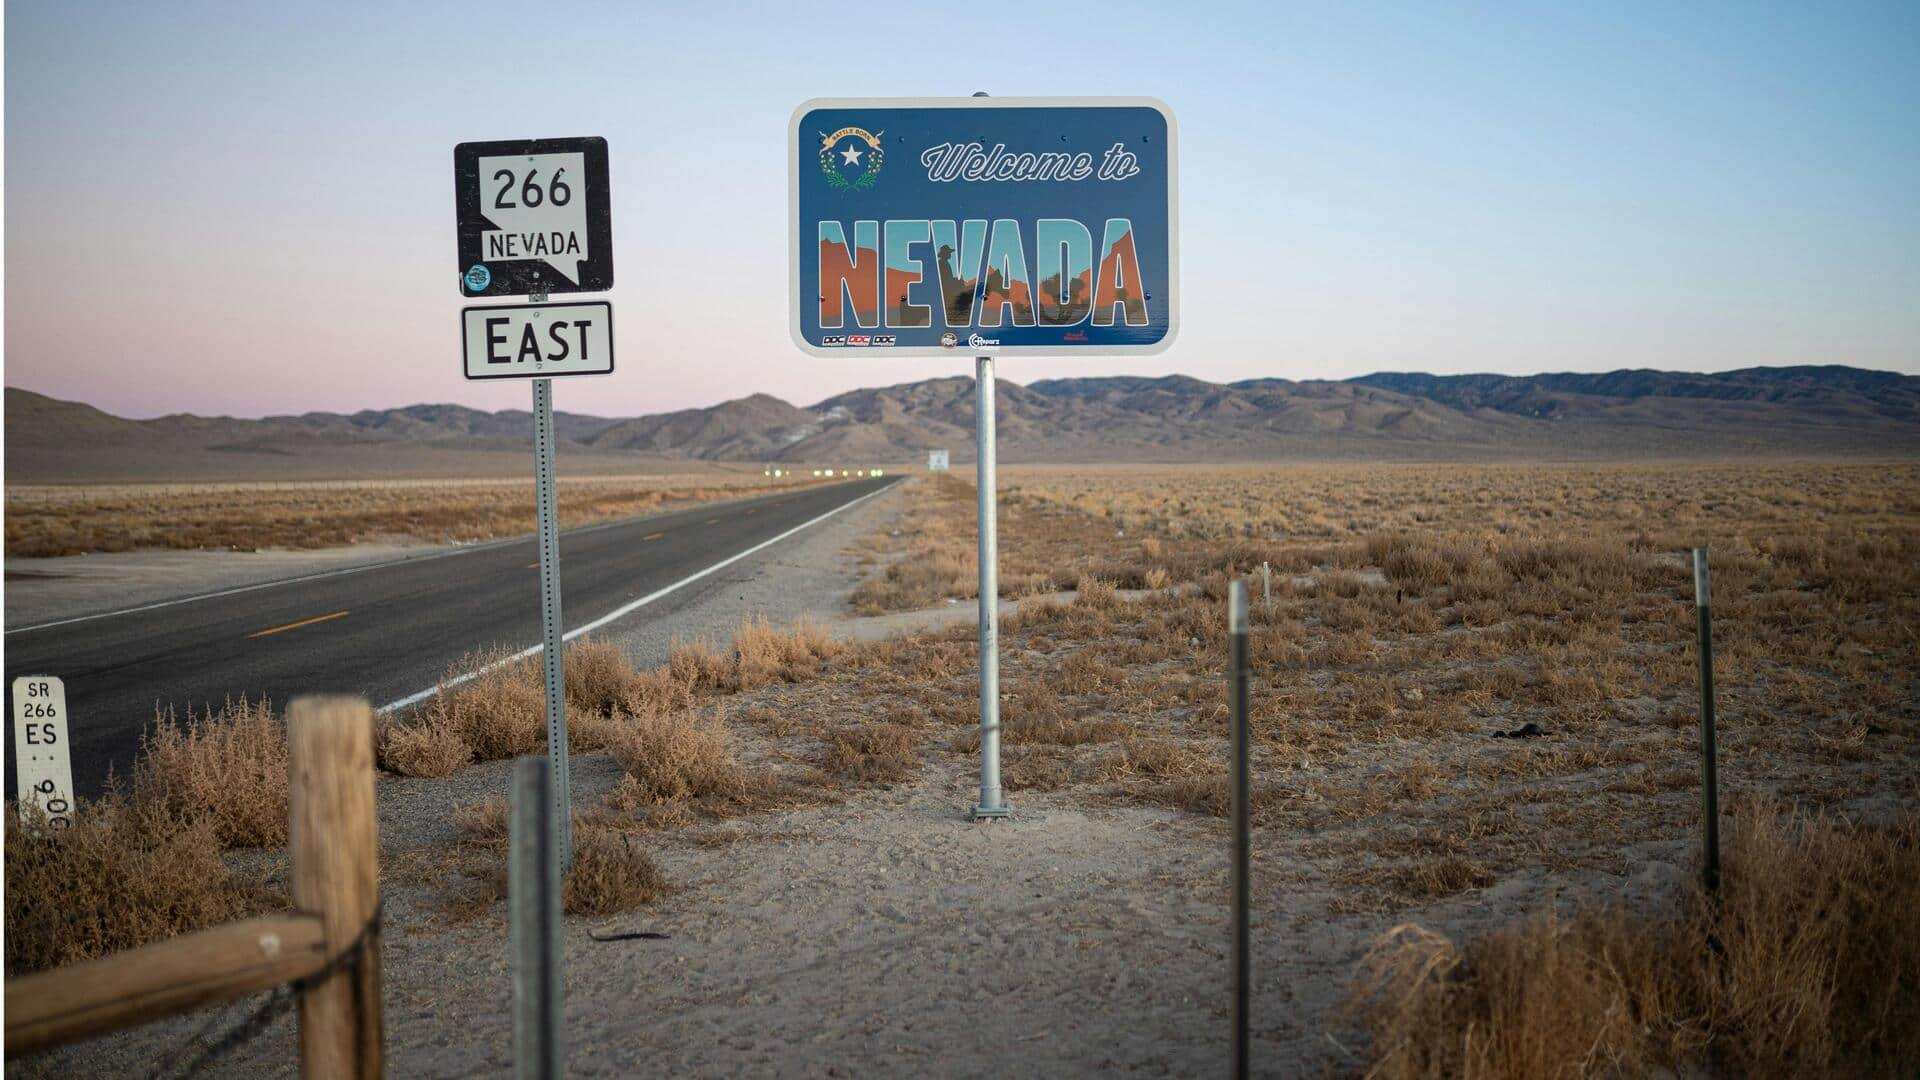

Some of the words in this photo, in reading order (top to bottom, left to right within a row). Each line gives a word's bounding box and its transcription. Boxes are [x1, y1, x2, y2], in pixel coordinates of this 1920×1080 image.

[920, 142, 1093, 182] Welcome
[1097, 143, 1140, 181] to
[493, 167, 571, 209] 266
[489, 230, 581, 258] NEVADA
[818, 218, 1149, 329] NEVADA
[486, 317, 592, 364] EAST
[28, 682, 49, 697] SR
[24, 703, 56, 718] 266
[26, 723, 57, 745] ES
